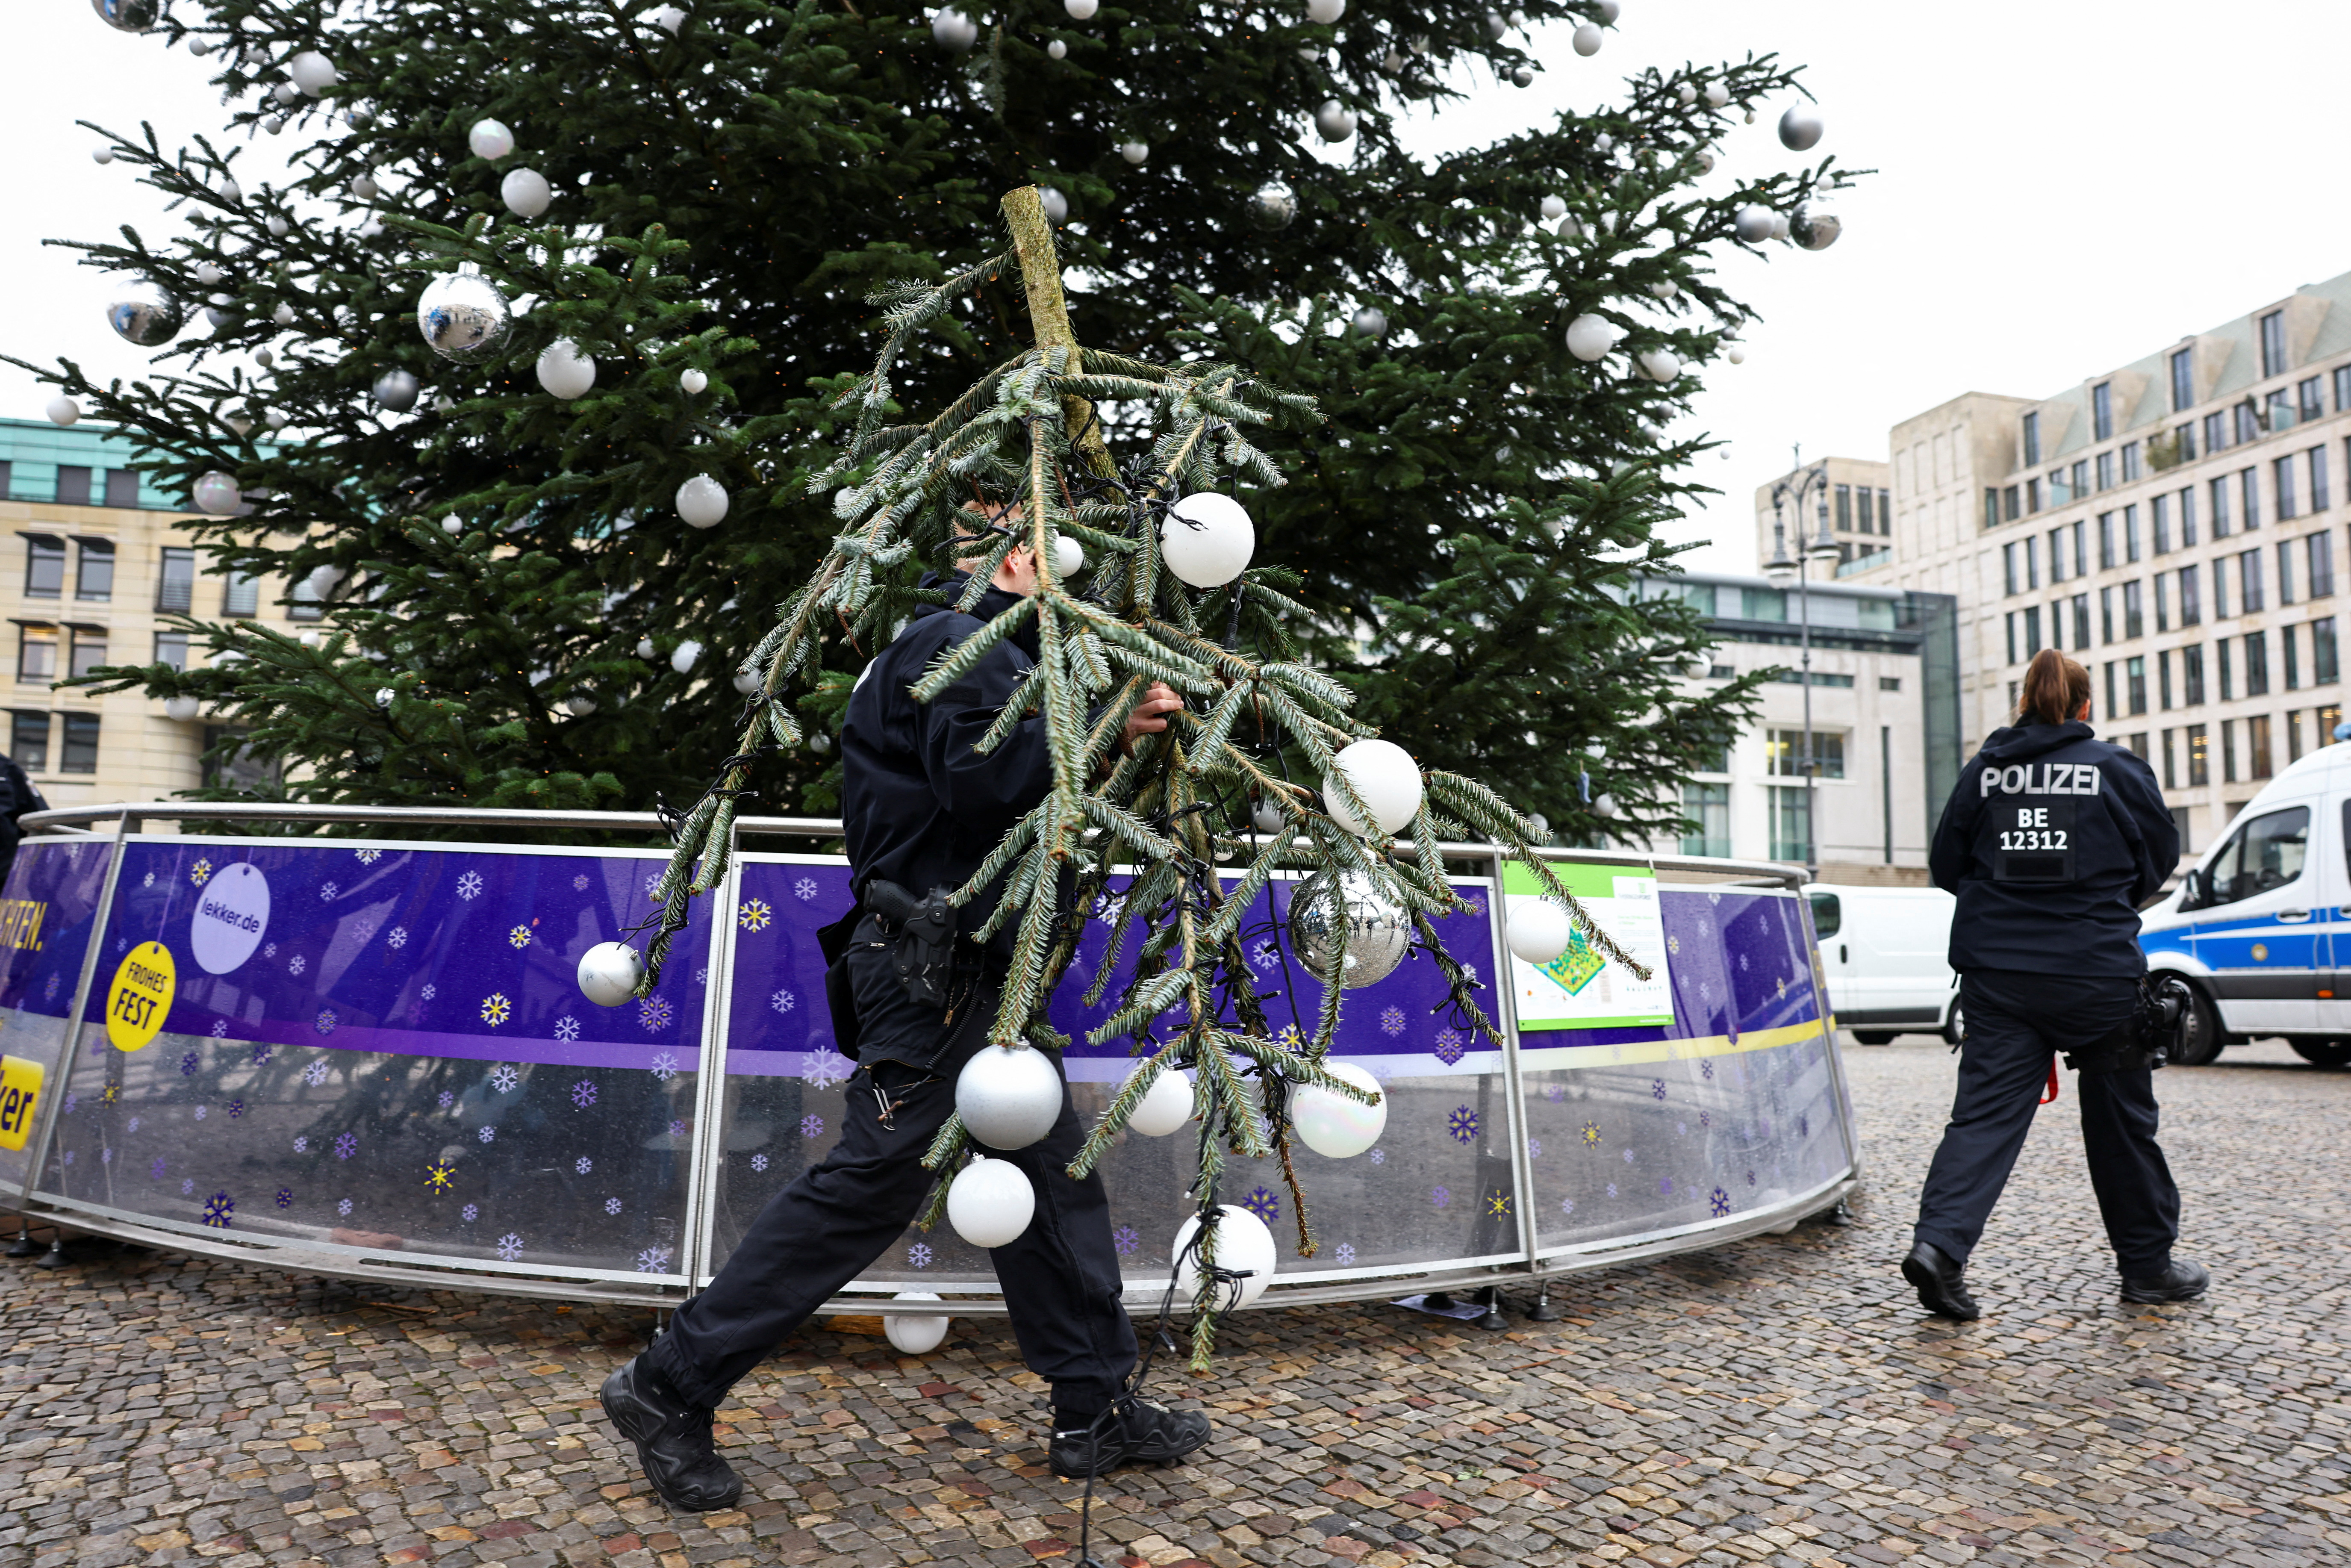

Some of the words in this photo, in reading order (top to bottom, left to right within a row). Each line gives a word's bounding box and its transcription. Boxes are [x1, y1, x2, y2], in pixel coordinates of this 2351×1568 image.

[1980, 763, 2101, 798] POLIZEI
[2018, 808, 2048, 828] BE
[2000, 830, 2068, 850] 12312
[200, 897, 259, 933] lekker.de
[126, 961, 167, 993] FROHES
[113, 987, 158, 1030] FEST
[0, 1070, 34, 1134] er
